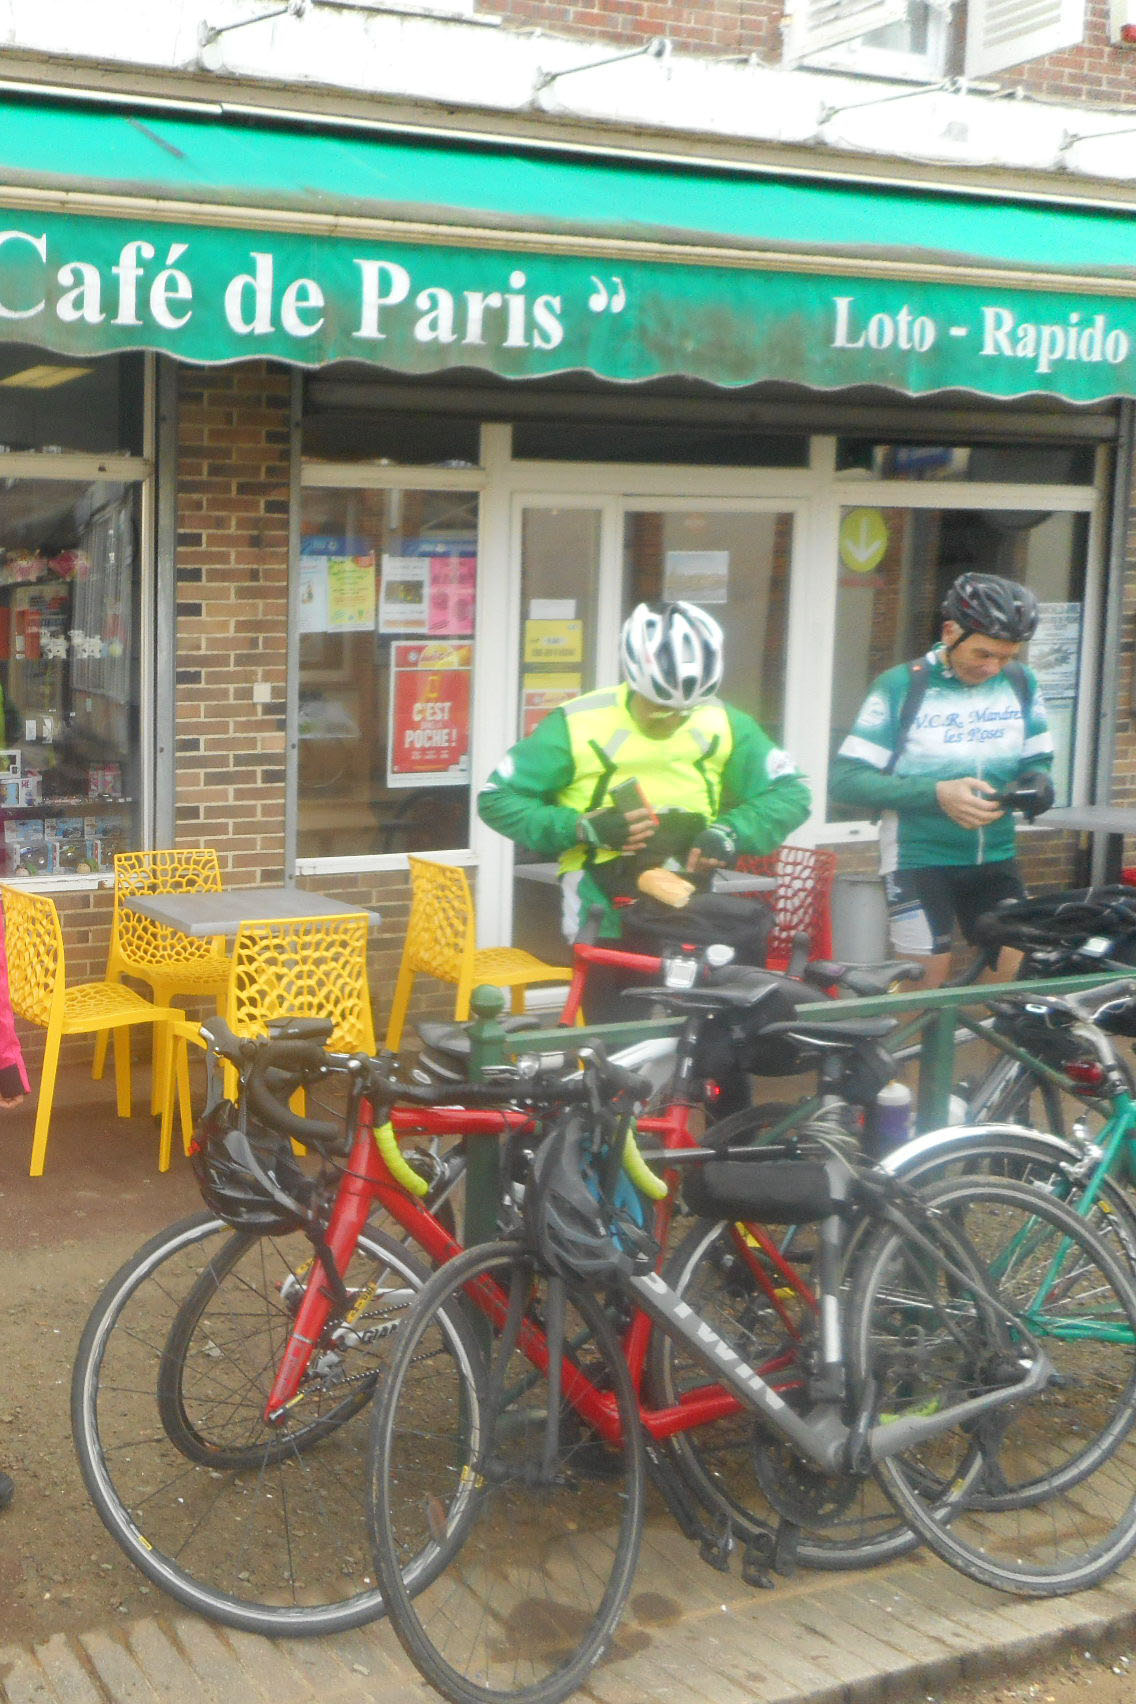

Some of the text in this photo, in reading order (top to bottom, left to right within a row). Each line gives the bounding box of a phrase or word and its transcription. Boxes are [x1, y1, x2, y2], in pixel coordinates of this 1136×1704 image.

[223, 252, 326, 337] de
[350, 257, 564, 351] Paris
[830, 296, 937, 352] Loto
[979, 306, 1131, 374] Rapido
[412, 702, 452, 722] C'EST
[968, 705, 1022, 723] Mandre
[362, 1322, 399, 1345] GIAN
